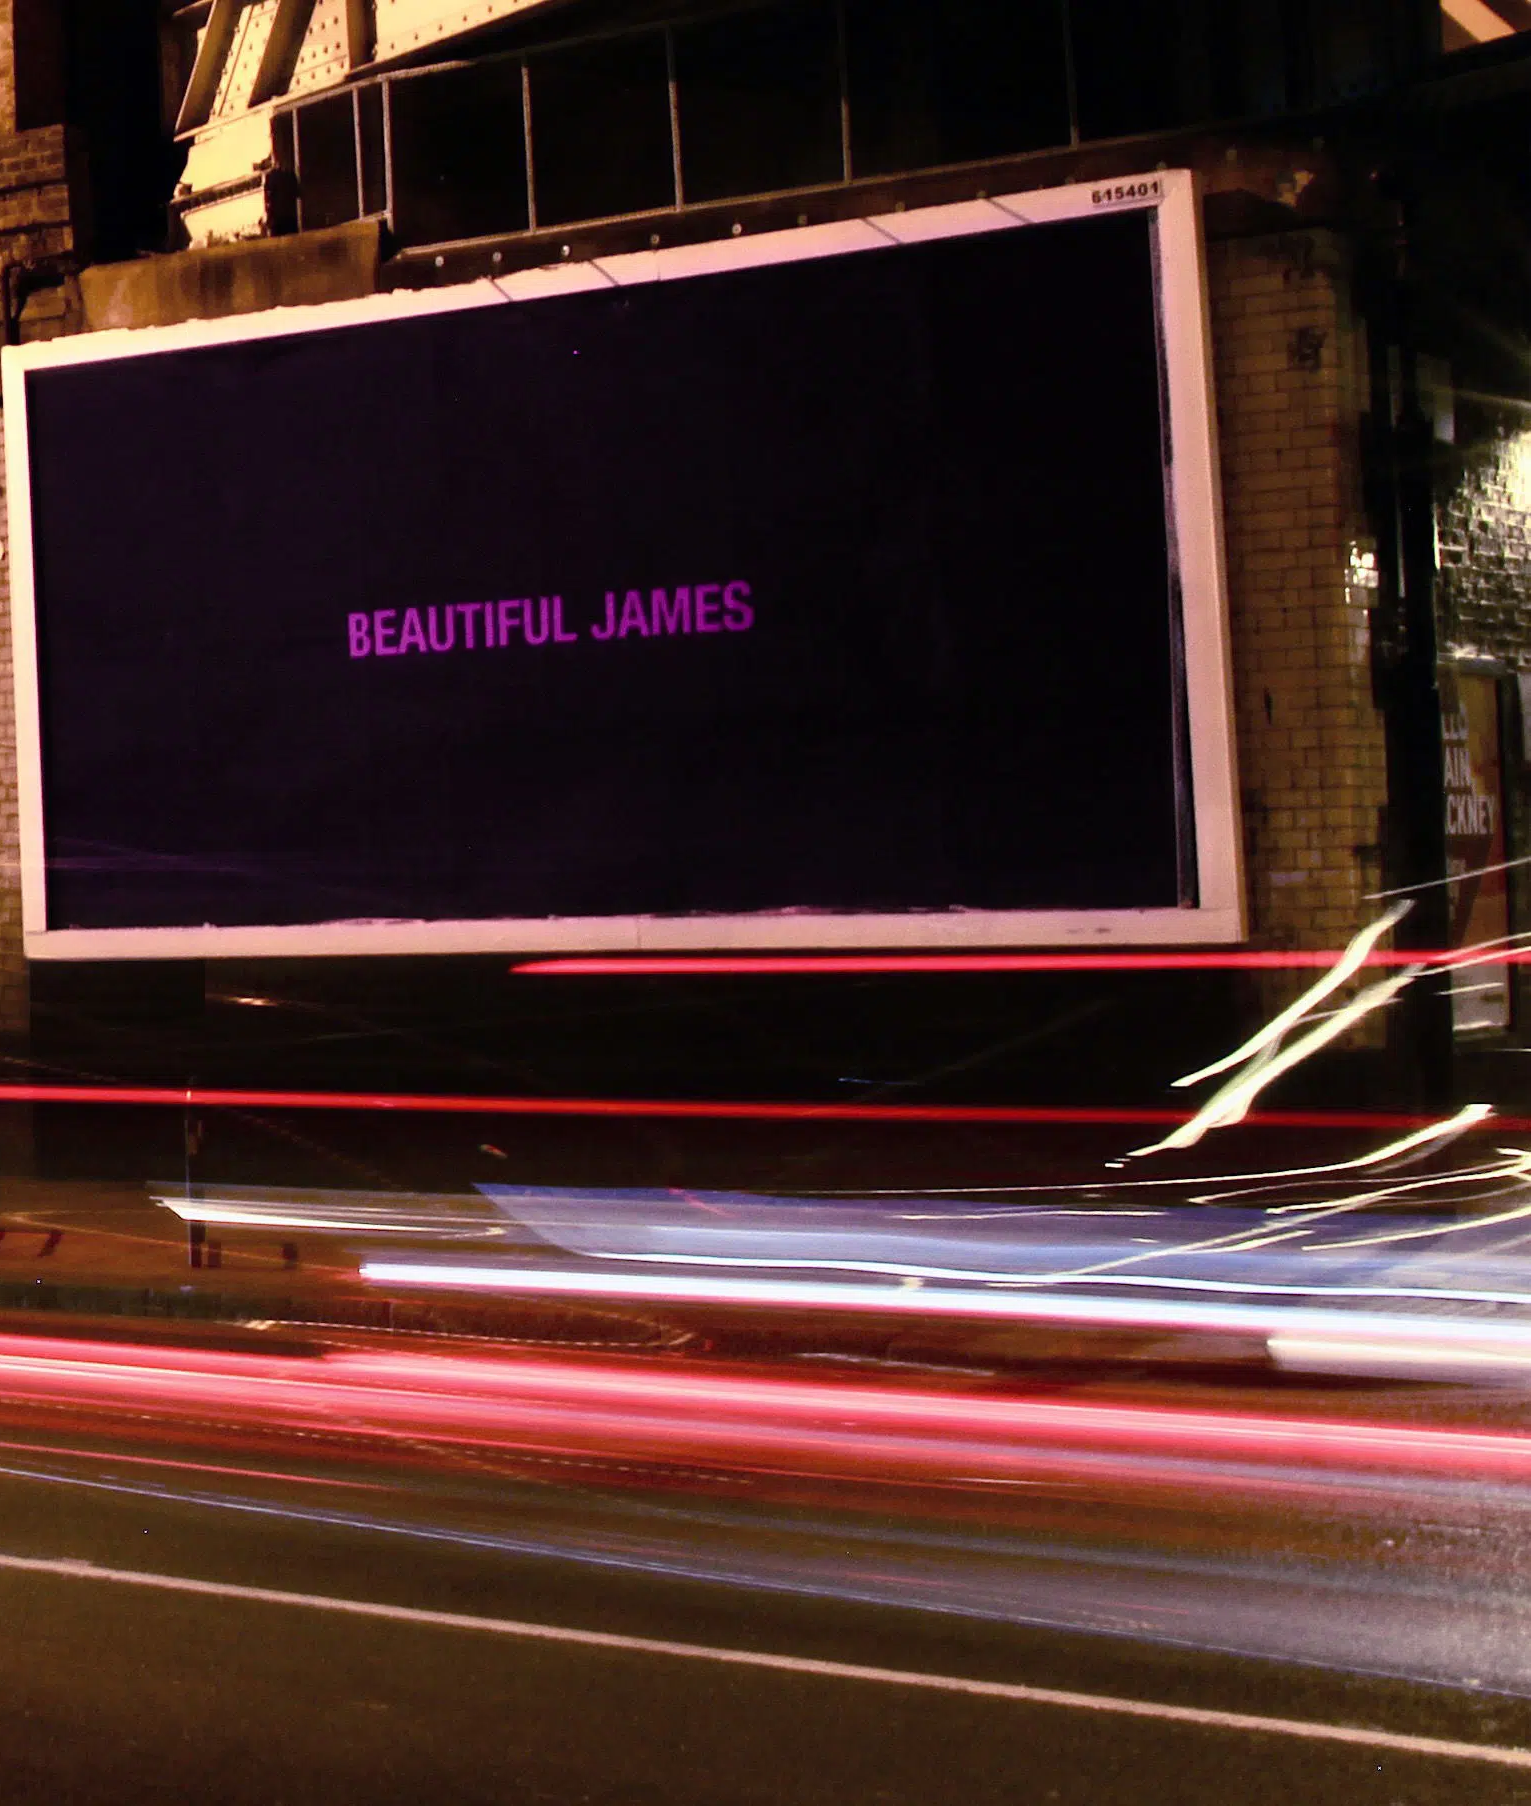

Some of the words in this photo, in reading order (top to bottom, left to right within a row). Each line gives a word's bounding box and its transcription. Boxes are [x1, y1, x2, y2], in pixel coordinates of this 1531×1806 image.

[347, 595, 578, 659] BEAUTIFUL
[590, 580, 755, 641] JAMES
[1443, 745, 1472, 788] AIN
[1444, 792, 1496, 836] CKNEY
